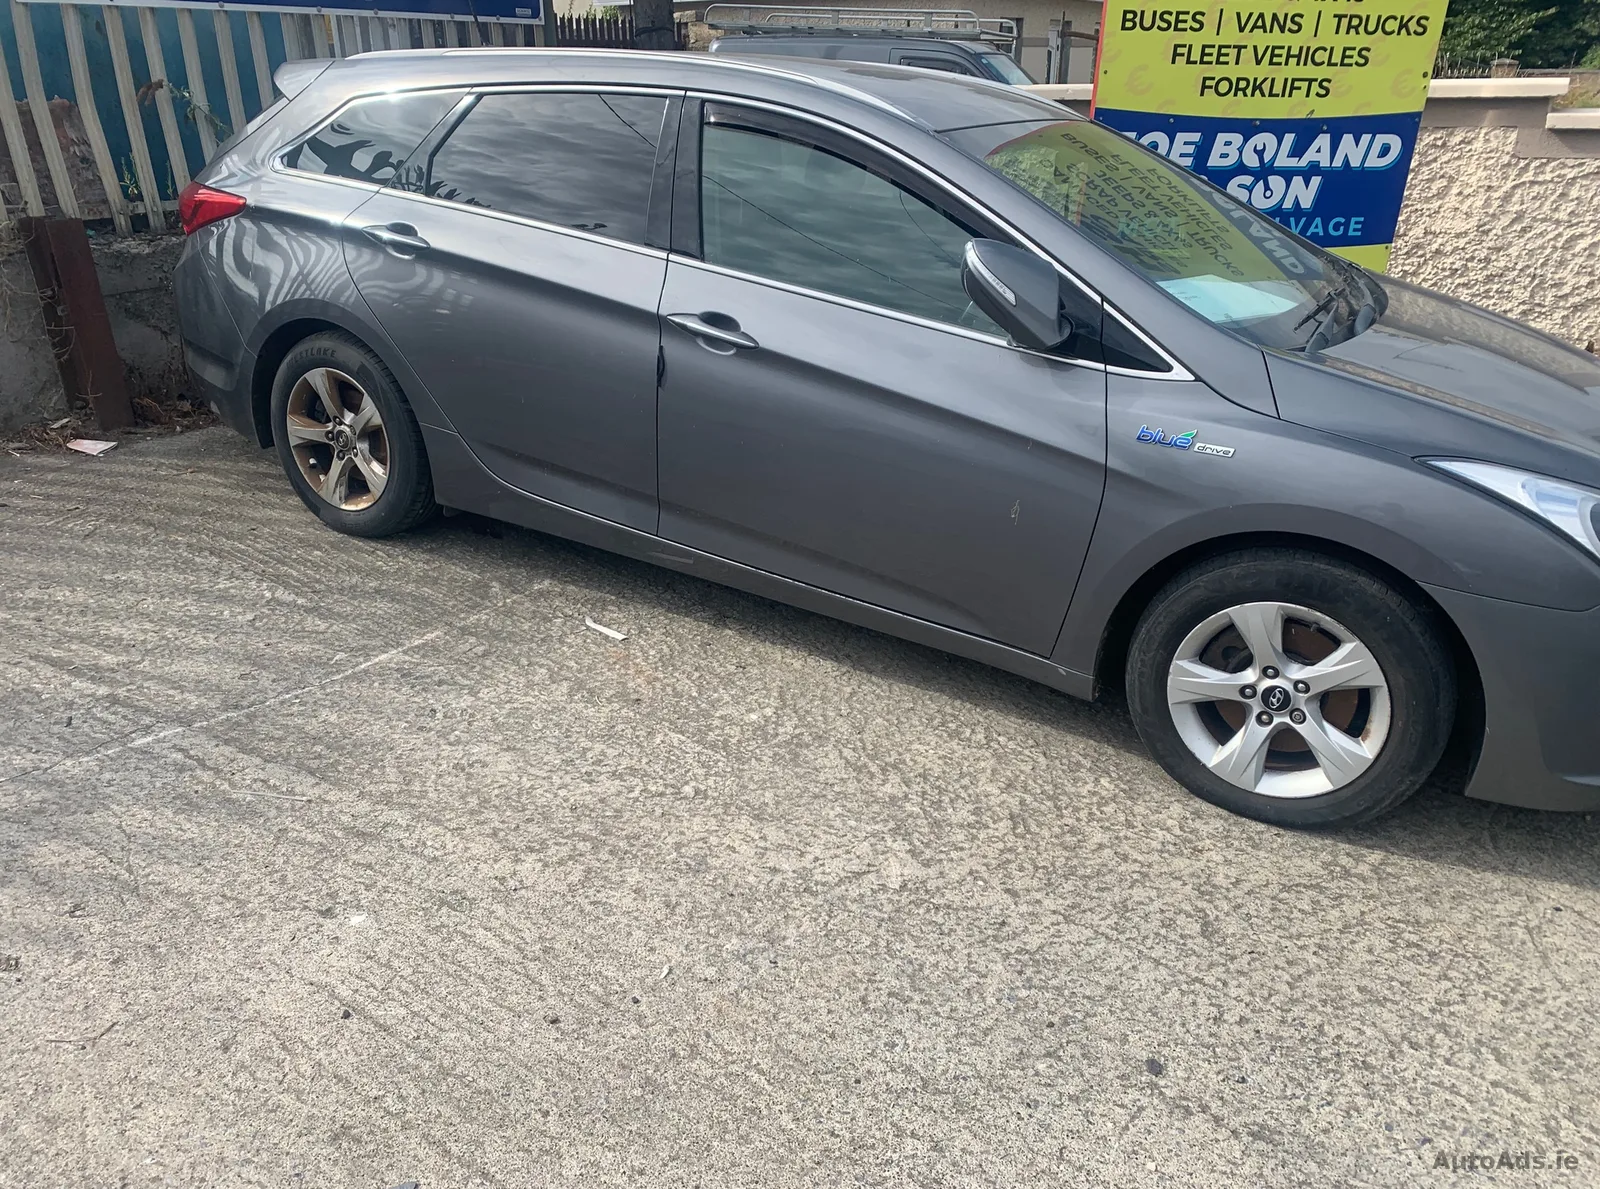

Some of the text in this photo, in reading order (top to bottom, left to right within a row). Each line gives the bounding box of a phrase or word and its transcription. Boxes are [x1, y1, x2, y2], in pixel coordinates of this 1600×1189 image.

[1121, 9, 1206, 32] BUSES
[1236, 11, 1304, 34] VANS
[1333, 13, 1430, 36] TRUCKS
[1171, 44, 1371, 67] FLEET VEHICLES
[1200, 76, 1332, 98] FORKLIFTS
[1207, 132, 1403, 170] BOLAND
[1226, 174, 1323, 211] SON
[1275, 217, 1364, 236] VAGE
[1136, 424, 1232, 456] blue drive
